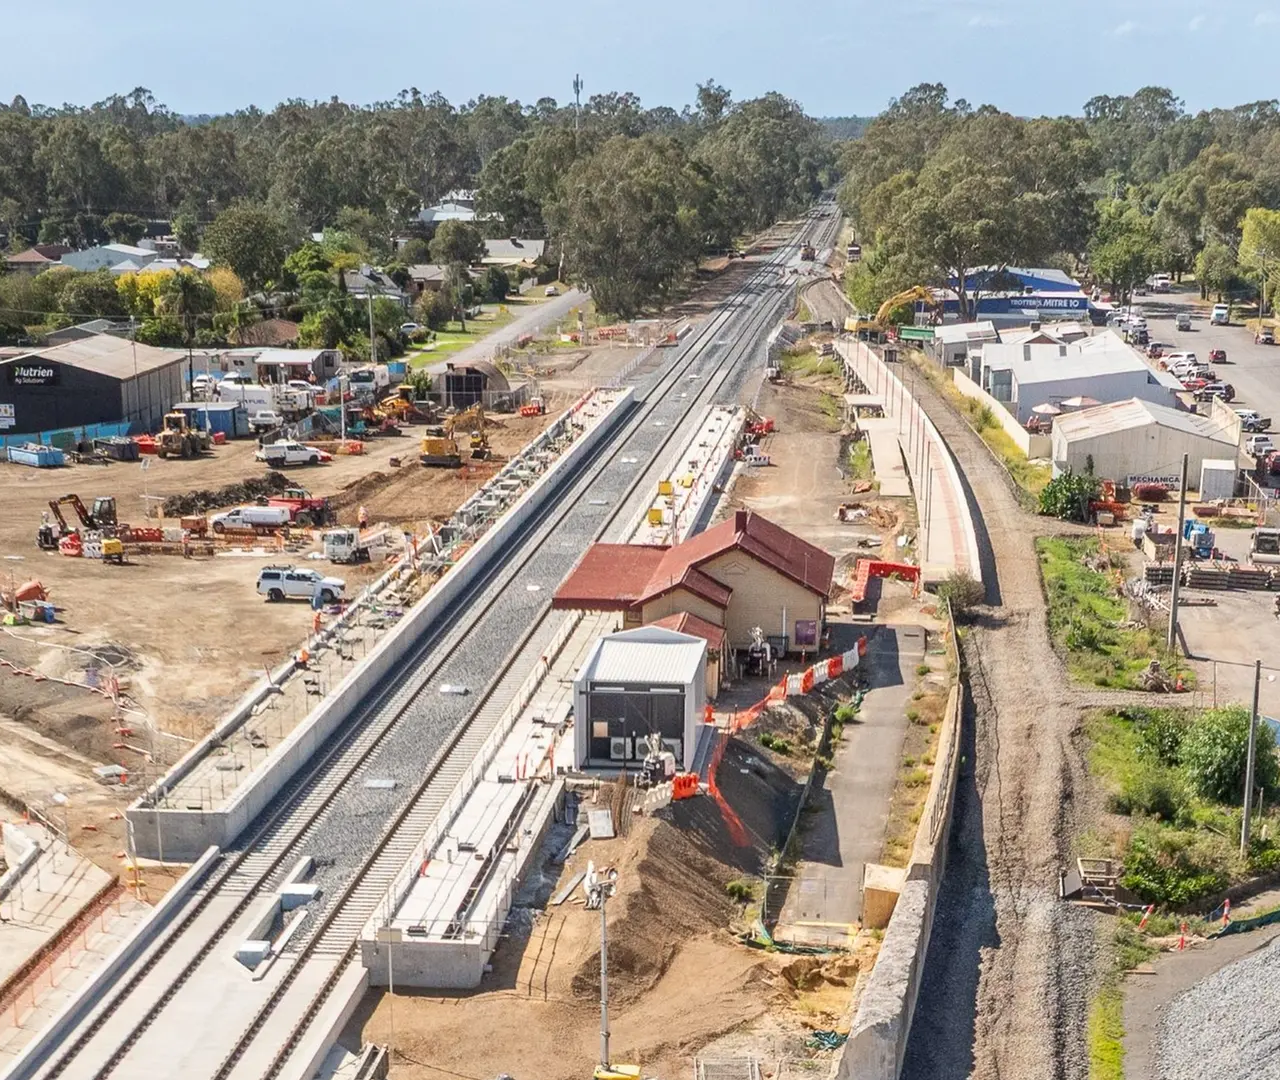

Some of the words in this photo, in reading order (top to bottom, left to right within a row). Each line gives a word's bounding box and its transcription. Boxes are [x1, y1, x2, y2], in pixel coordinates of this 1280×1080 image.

[1042, 299, 1068, 307] MITRE
[1069, 299, 1080, 307] 10
[14, 366, 54, 377] Nutrien
